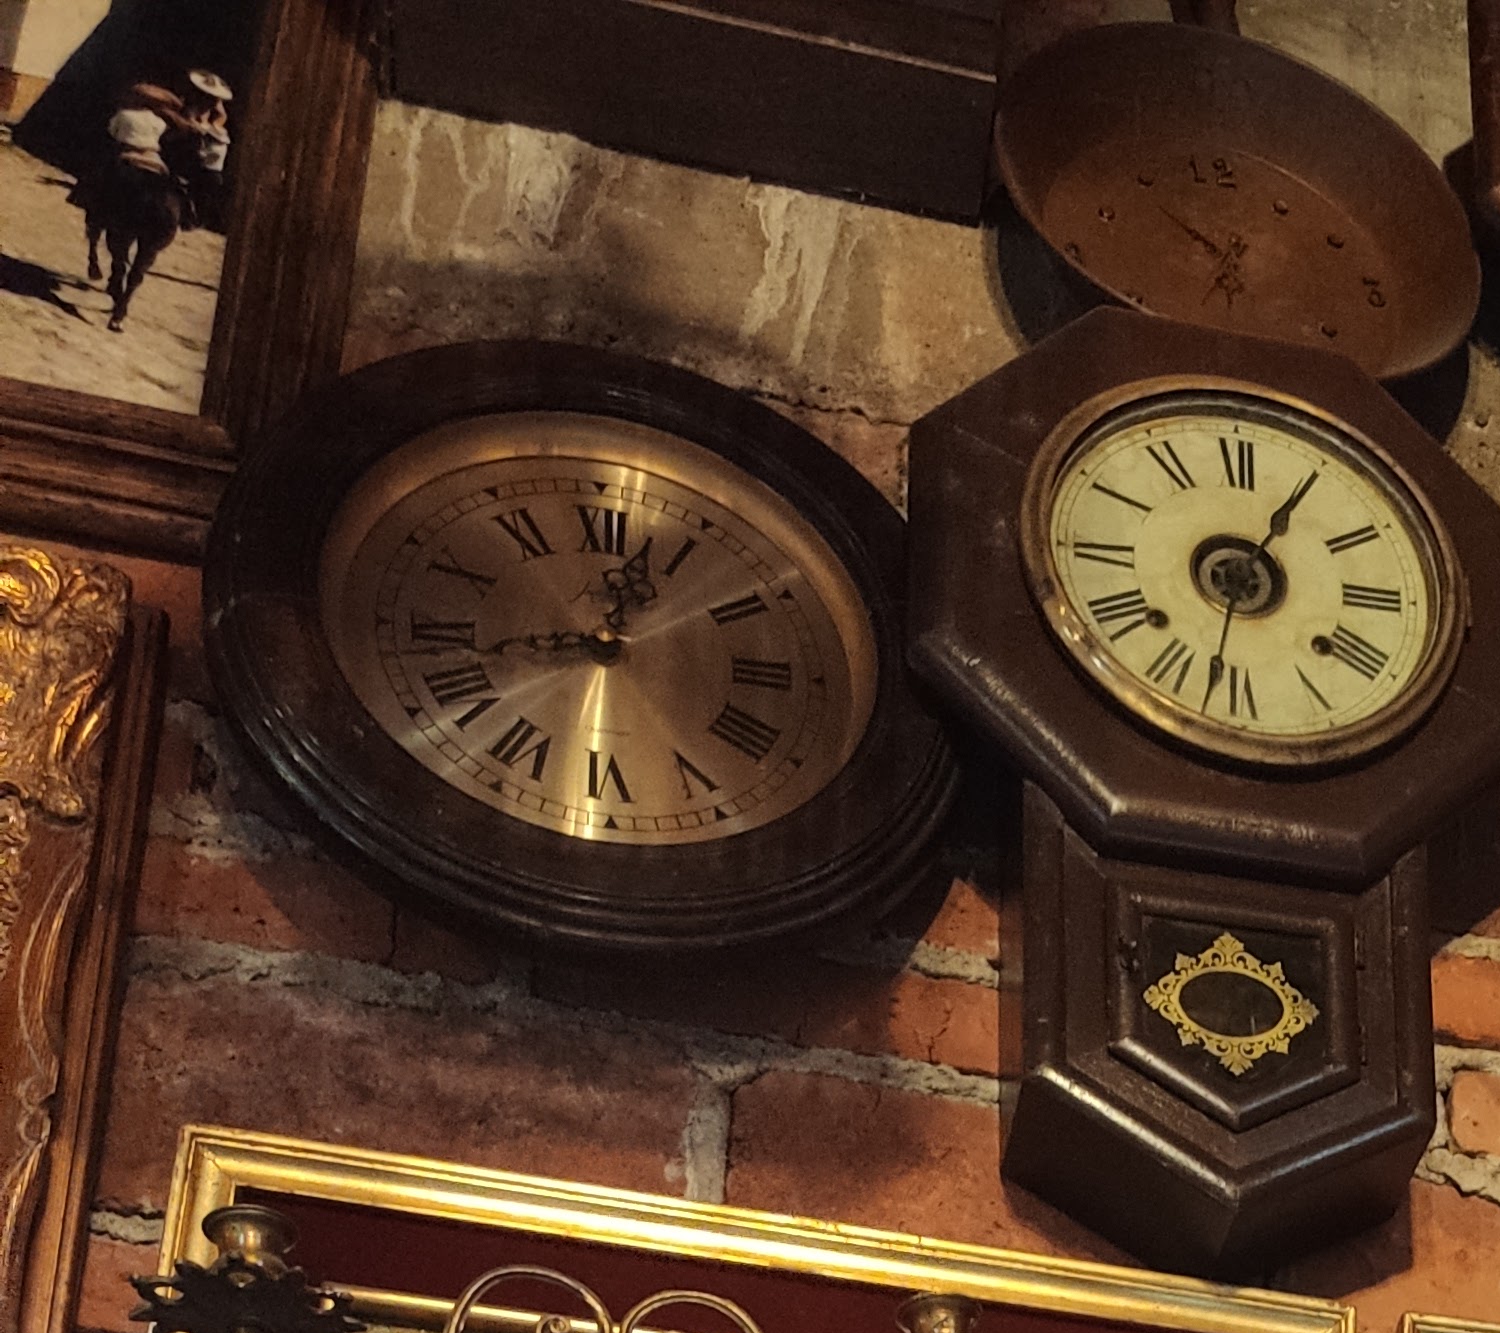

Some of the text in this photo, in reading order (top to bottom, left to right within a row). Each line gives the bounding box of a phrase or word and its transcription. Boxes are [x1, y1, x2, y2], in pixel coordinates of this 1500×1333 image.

[1188, 157, 1236, 190] 12
[1145, 440, 1196, 494] XI
[1219, 437, 1258, 492] XII
[493, 508, 556, 560] XI
[575, 505, 628, 556] XII
[665, 536, 695, 577] I
[1074, 535, 1135, 569] IX
[1325, 524, 1381, 555] II
[428, 546, 496, 599] X
[1342, 583, 1401, 612] III
[710, 594, 768, 626] II
[731, 655, 792, 691] III
[1145, 638, 1195, 694] VII
[423, 661, 501, 732] VIII
[1229, 665, 1259, 721] VI
[486, 716, 553, 782] VII
[709, 702, 780, 764] IIII
[586, 747, 635, 803] VI
[674, 749, 720, 800] V
